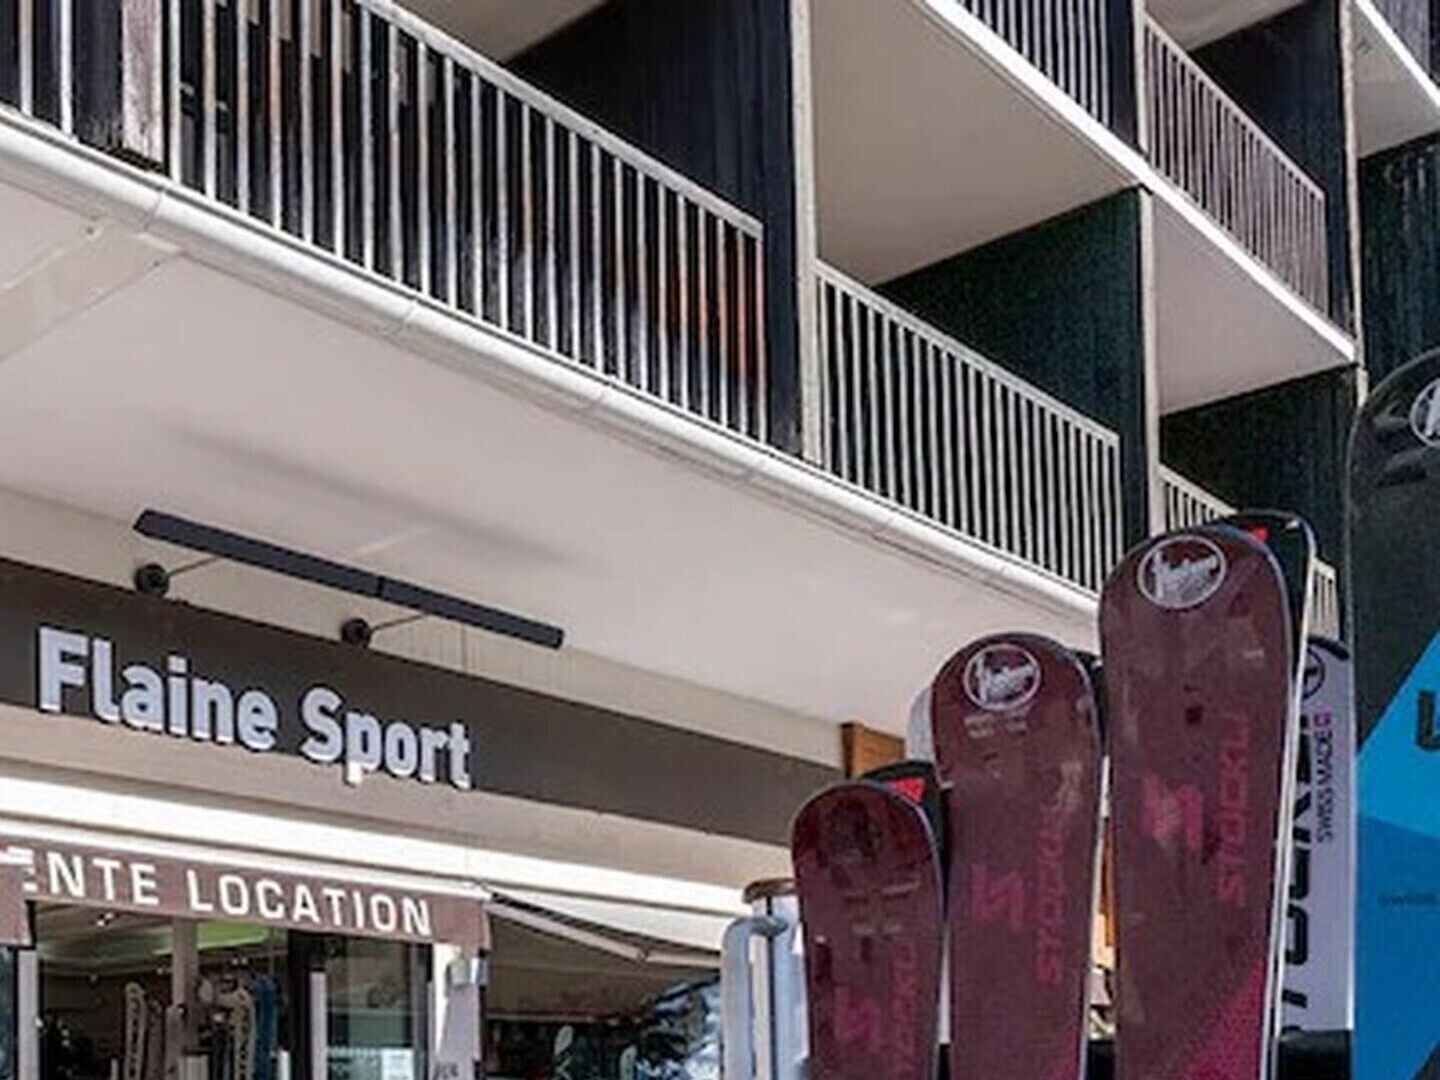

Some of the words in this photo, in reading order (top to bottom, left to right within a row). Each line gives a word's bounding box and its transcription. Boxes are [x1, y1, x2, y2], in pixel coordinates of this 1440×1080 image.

[38, 627, 278, 752] Flaine
[301, 687, 472, 789] Sport
[186, 869, 433, 936] LOCATION
